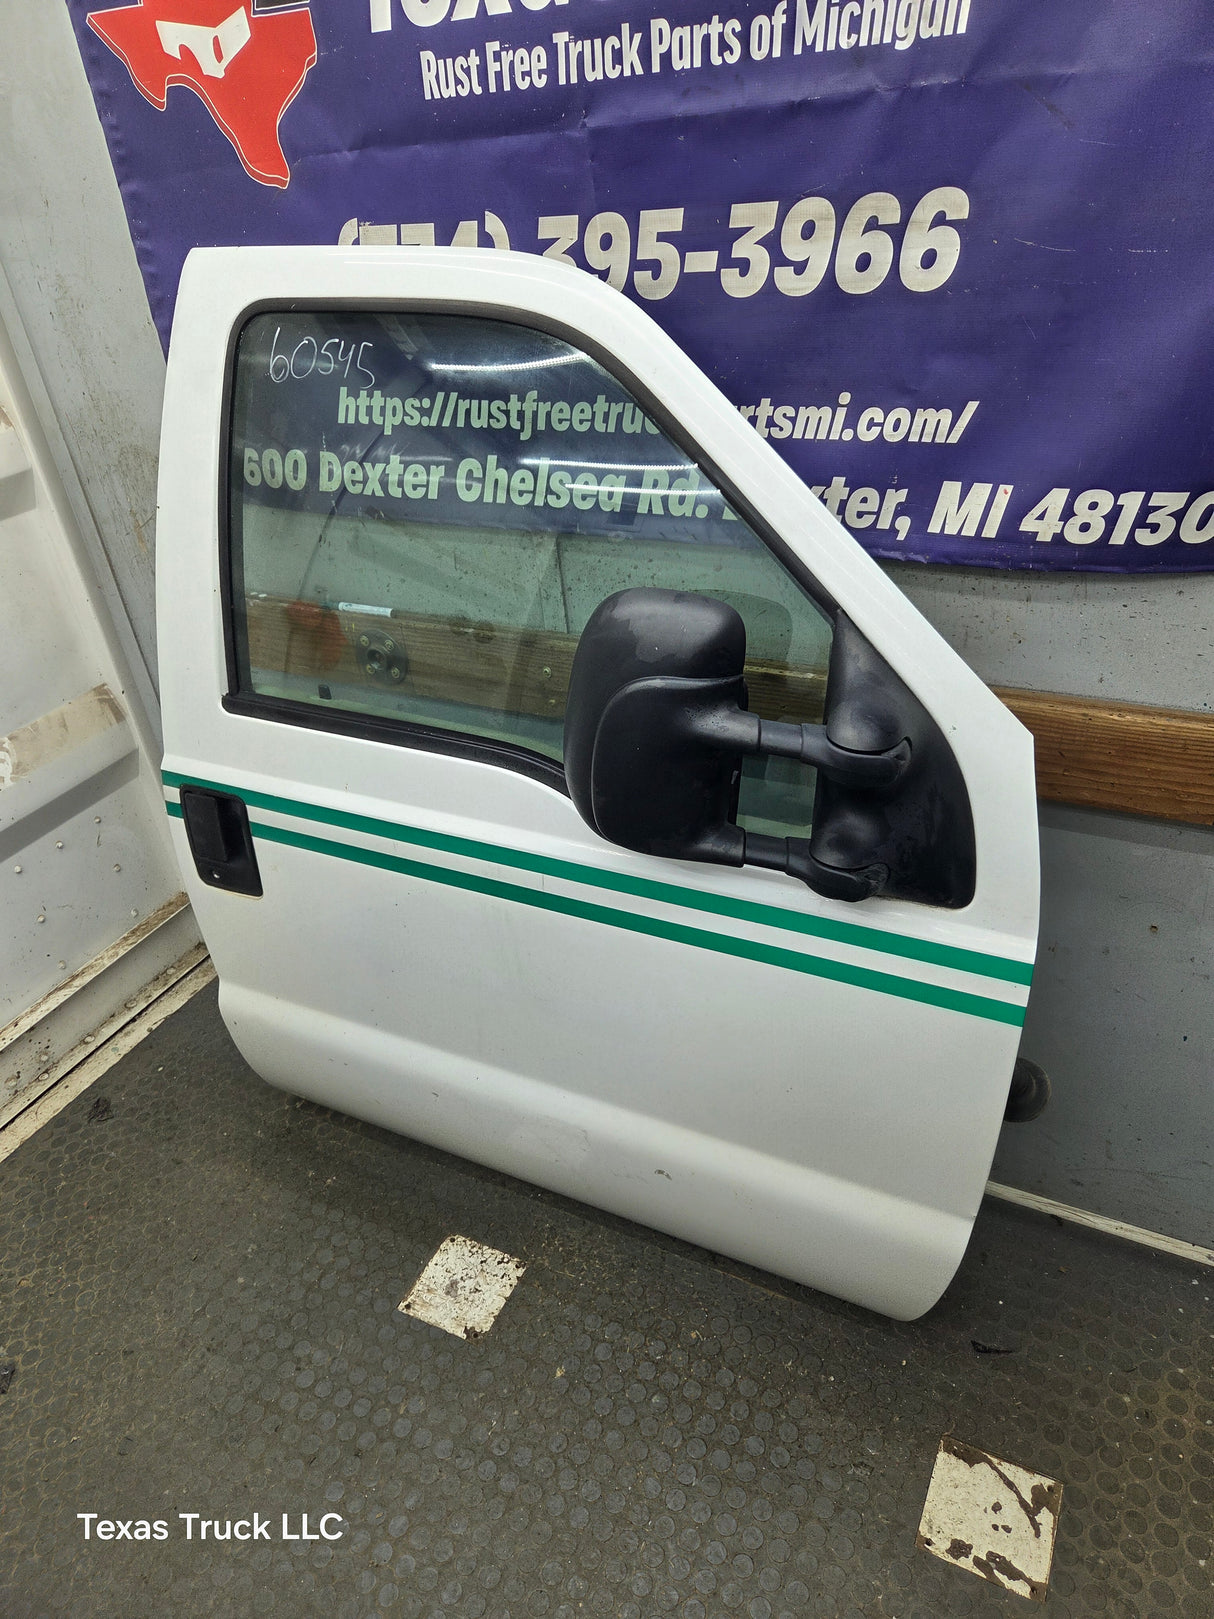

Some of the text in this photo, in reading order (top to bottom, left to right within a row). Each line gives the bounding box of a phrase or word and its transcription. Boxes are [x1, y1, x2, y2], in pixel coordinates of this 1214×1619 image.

[419, 0, 972, 101] Rust Free Truck Parts of Michigan
[269, 326, 376, 390] 60545
[243, 447, 308, 491] 600
[318, 450, 446, 501] Dexter
[455, 454, 627, 514] Chelsea
[636, 468, 709, 521] Rd.
[927, 480, 1015, 539] MI
[1018, 487, 1214, 547] 48130
